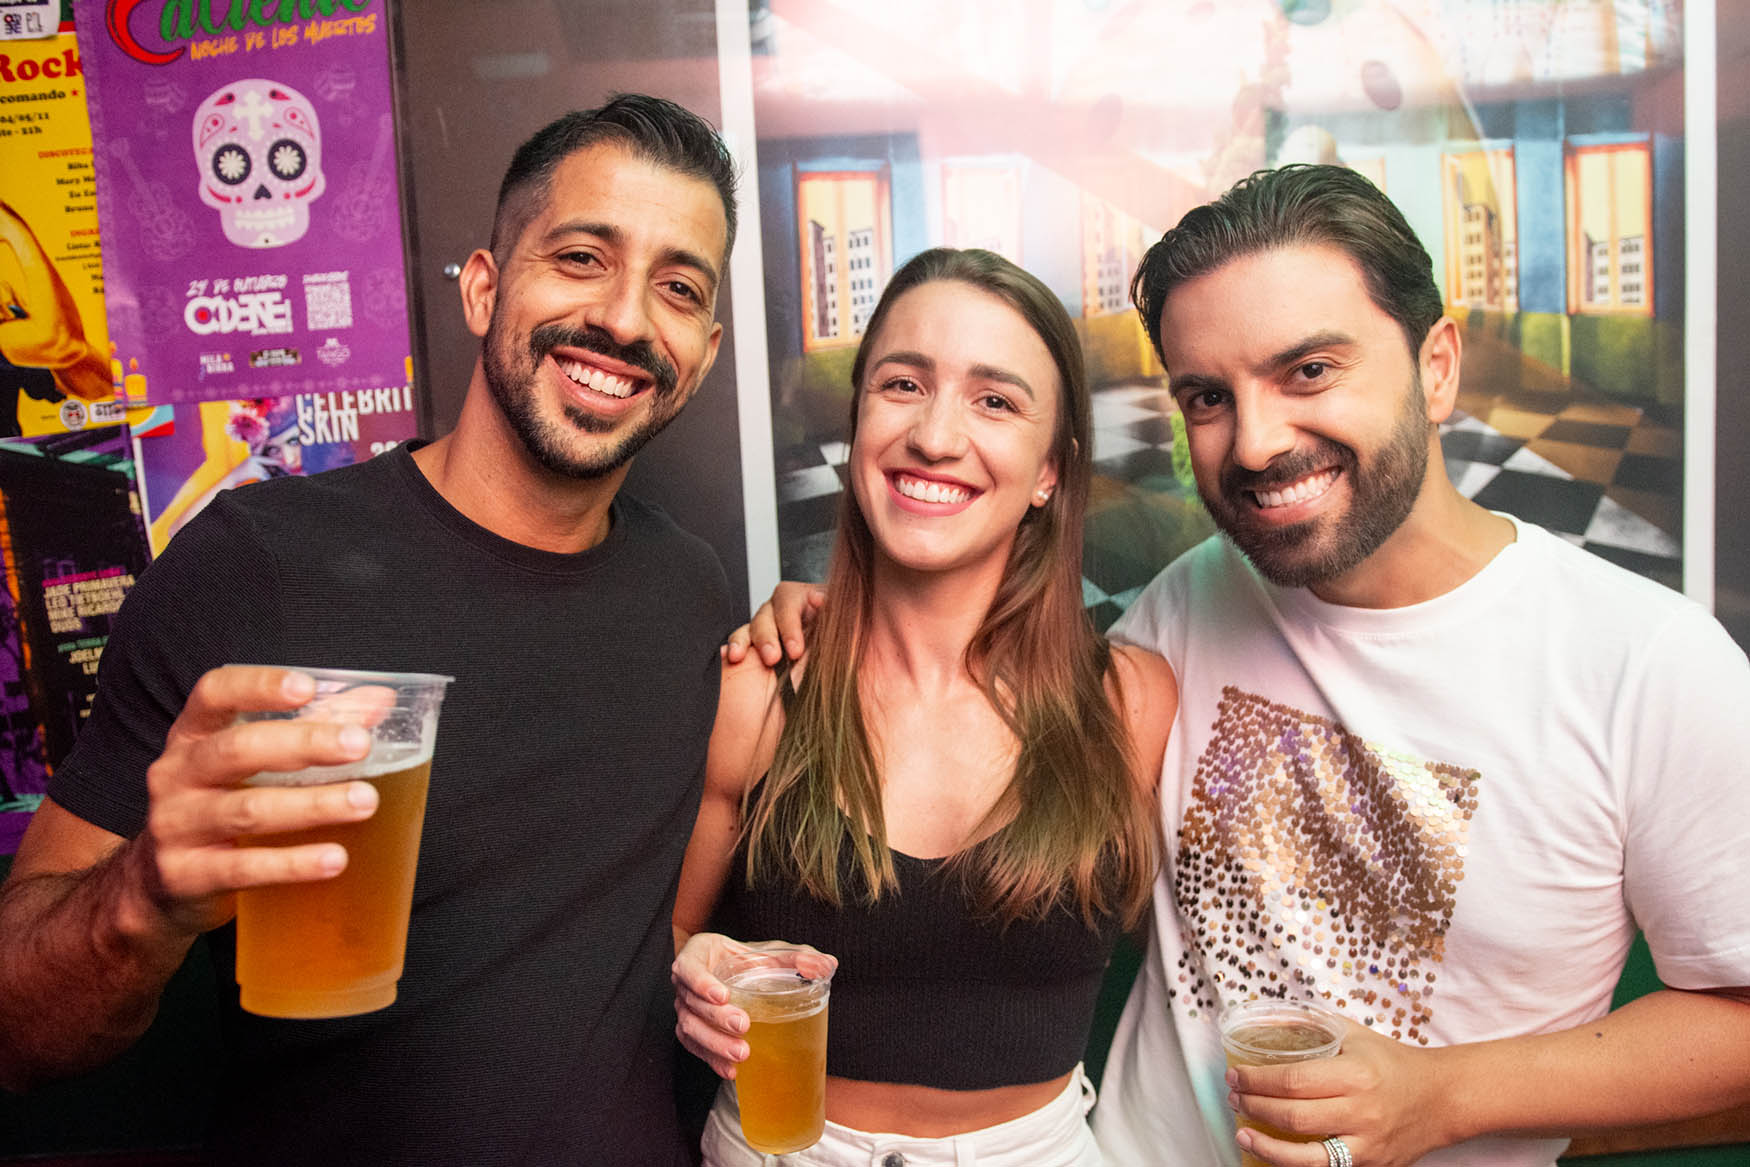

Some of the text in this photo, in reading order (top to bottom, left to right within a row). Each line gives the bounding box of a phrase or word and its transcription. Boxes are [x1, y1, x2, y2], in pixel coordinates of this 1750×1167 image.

[190, 14, 377, 61] NOCHE DE LOS MUERTOS
[297, 406, 360, 447] SKIN
